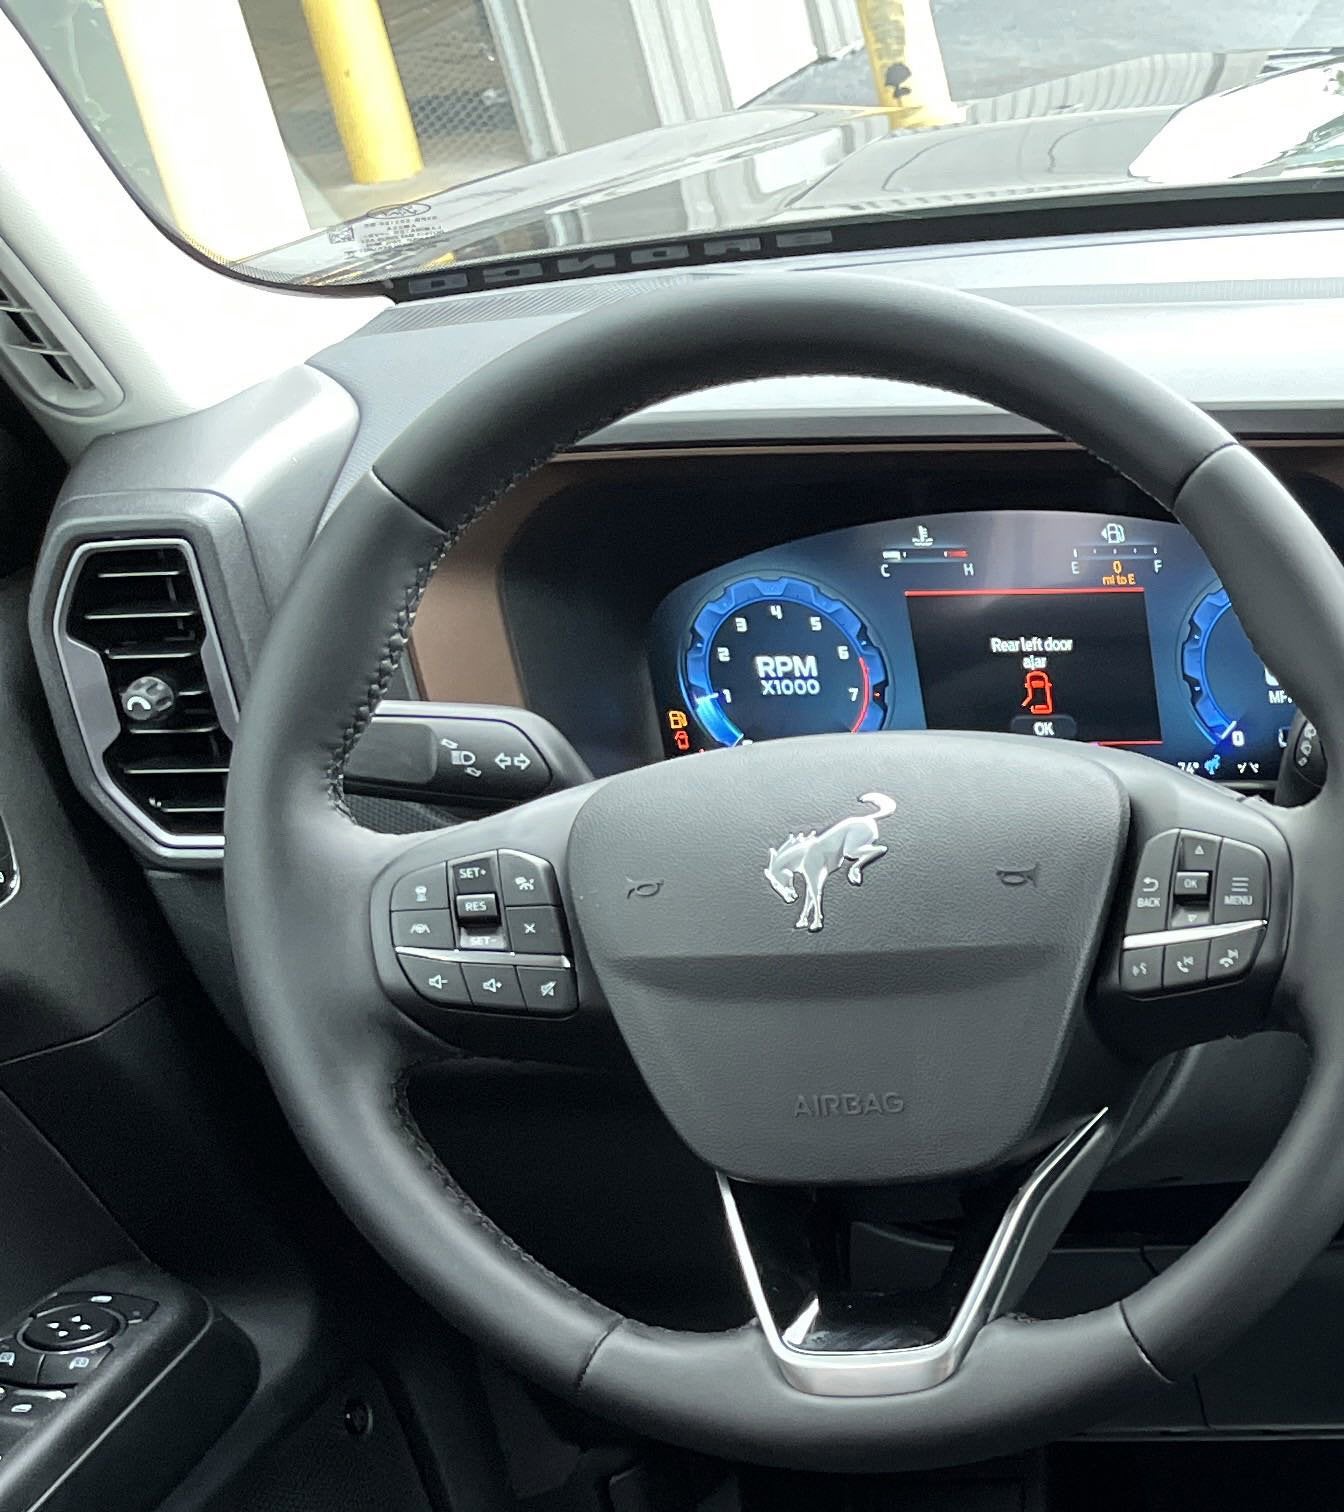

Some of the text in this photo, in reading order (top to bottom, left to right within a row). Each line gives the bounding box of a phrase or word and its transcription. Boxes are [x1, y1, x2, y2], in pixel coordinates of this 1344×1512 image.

[880, 563, 890, 578] C
[963, 563, 974, 577] H
[1071, 561, 1079, 575] E
[1113, 560, 1122, 574] 0
[1154, 560, 1163, 574] F
[1128, 573, 1136, 585] E
[770, 605, 783, 620] 4
[735, 617, 748, 633] 3
[810, 616, 823, 632] 5
[990, 636, 1073, 653] Rear left door
[717, 646, 731, 662] 2
[837, 645, 850, 660] 6
[754, 655, 818, 678] RPM
[1022, 655, 1047, 671] ajar
[760, 679, 821, 695] X1000
[848, 687, 859, 701] 7
[722, 689, 732, 703] 1
[1268, 689, 1293, 704] MP
[1033, 722, 1054, 737] OK
[1231, 730, 1245, 747] 0
[1184, 879, 1198, 888] OK
[465, 900, 487, 913] RES
[1136, 897, 1160, 908] BACK
[1224, 895, 1253, 906] MENU
[794, 1092, 905, 1118] AIRBAG
